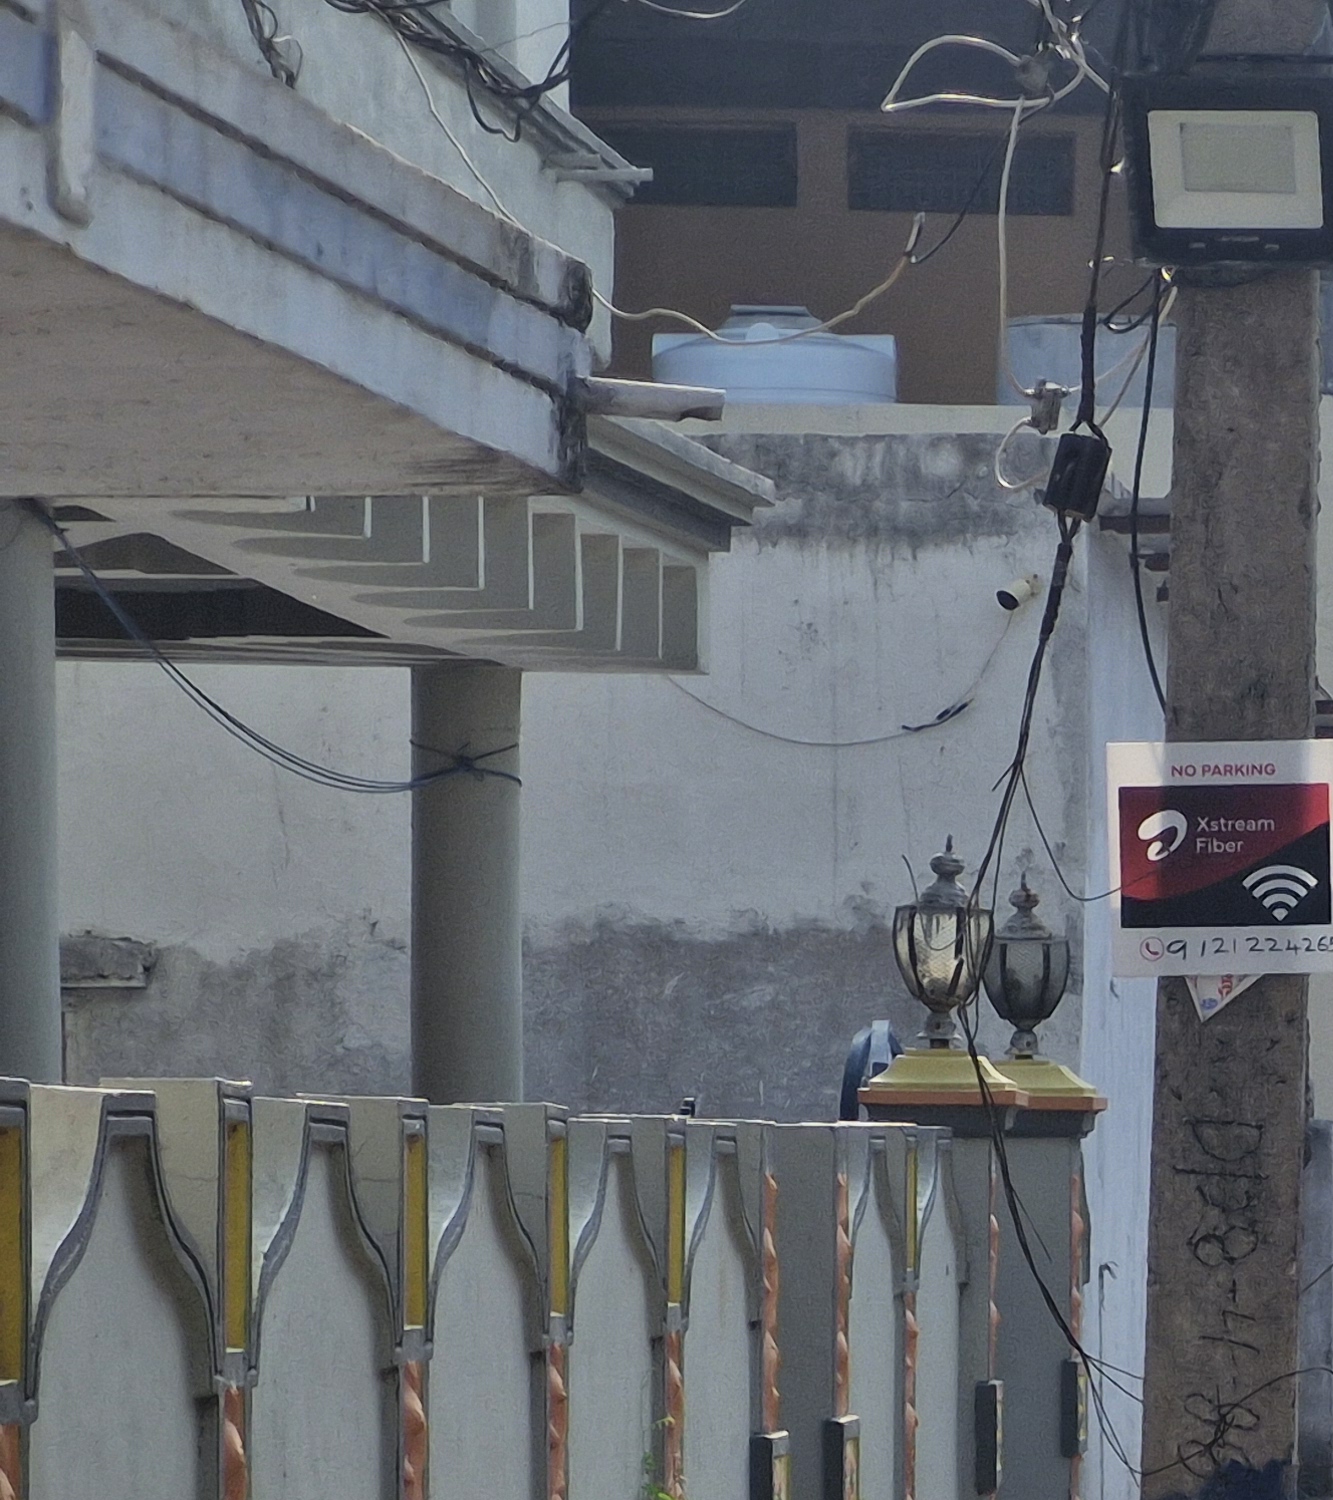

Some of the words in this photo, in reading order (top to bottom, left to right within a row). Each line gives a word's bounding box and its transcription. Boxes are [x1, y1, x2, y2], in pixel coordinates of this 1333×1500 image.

[1171, 764, 1197, 777] NO
[1201, 763, 1276, 777] PARKING
[1196, 816, 1275, 832] Xstream
[1195, 837, 1244, 854] Fiber
